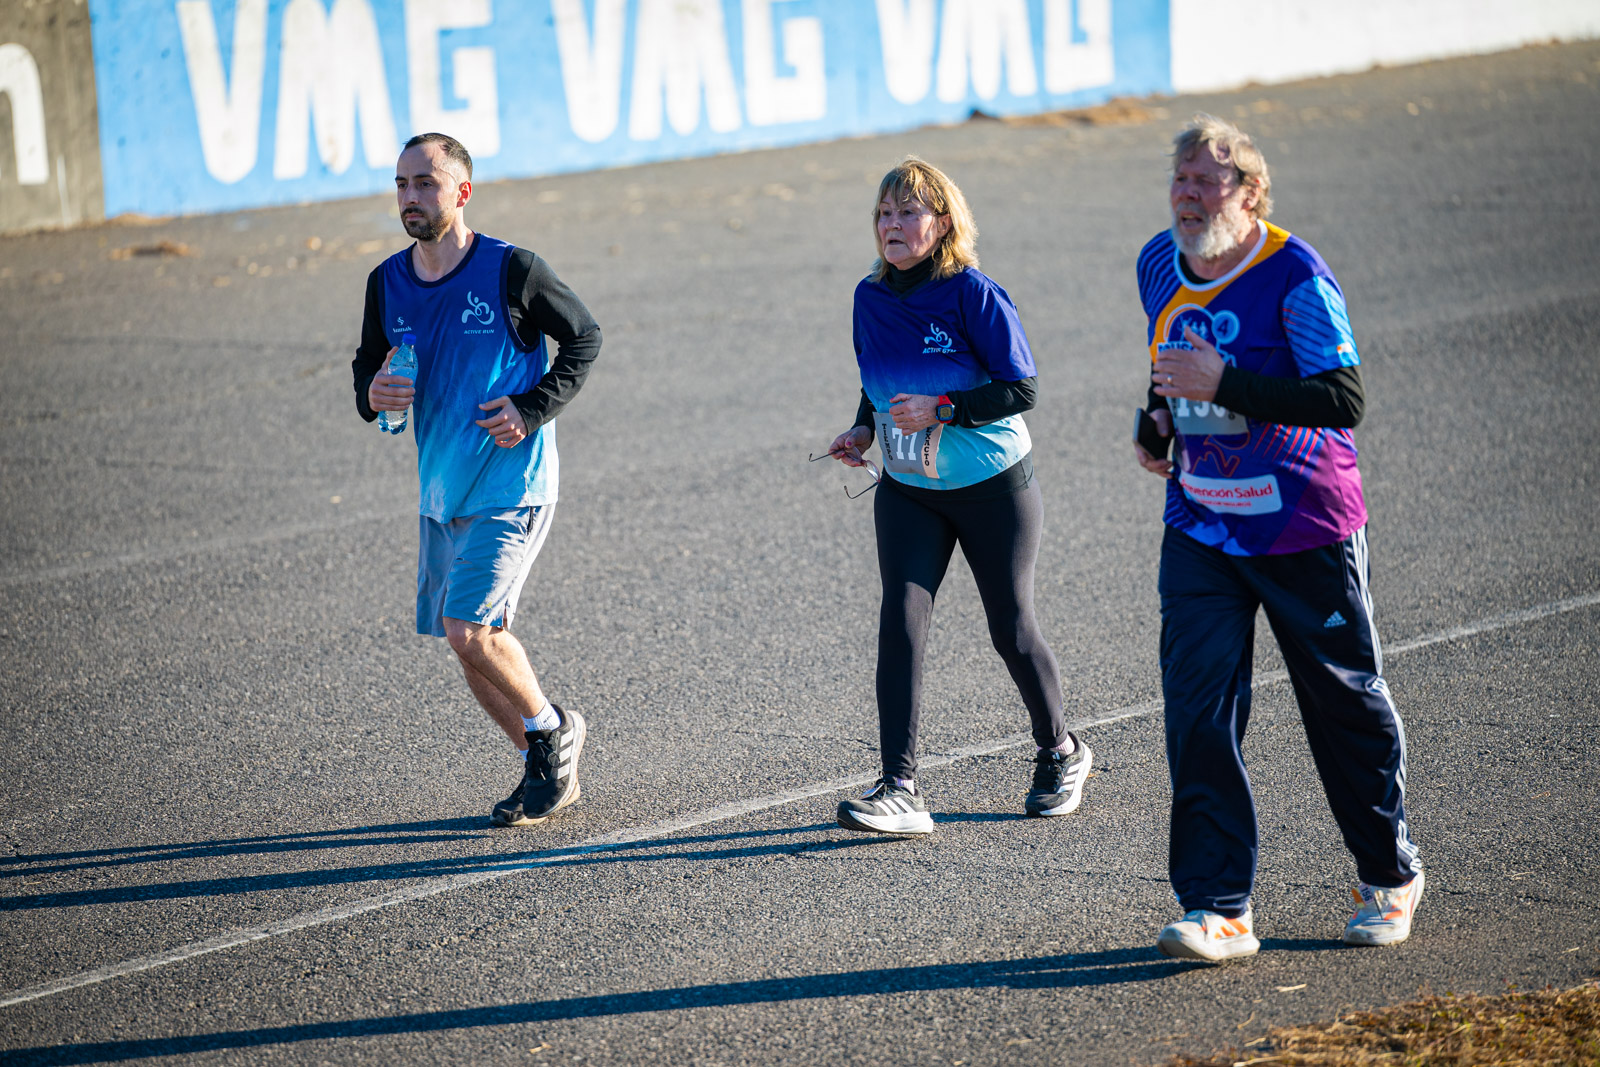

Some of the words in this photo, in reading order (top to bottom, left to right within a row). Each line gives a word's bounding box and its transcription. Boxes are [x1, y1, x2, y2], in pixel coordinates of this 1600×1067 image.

[177, 0, 499, 183] VMG
[552, 0, 826, 142] VMG
[875, 0, 1115, 103] VMG
[1217, 320, 1229, 338] 4
[881, 423, 893, 461] TIEMPO
[891, 427, 917, 461] 77
[923, 426, 933, 467] EXACTO
[1234, 483, 1273, 498] Salud
